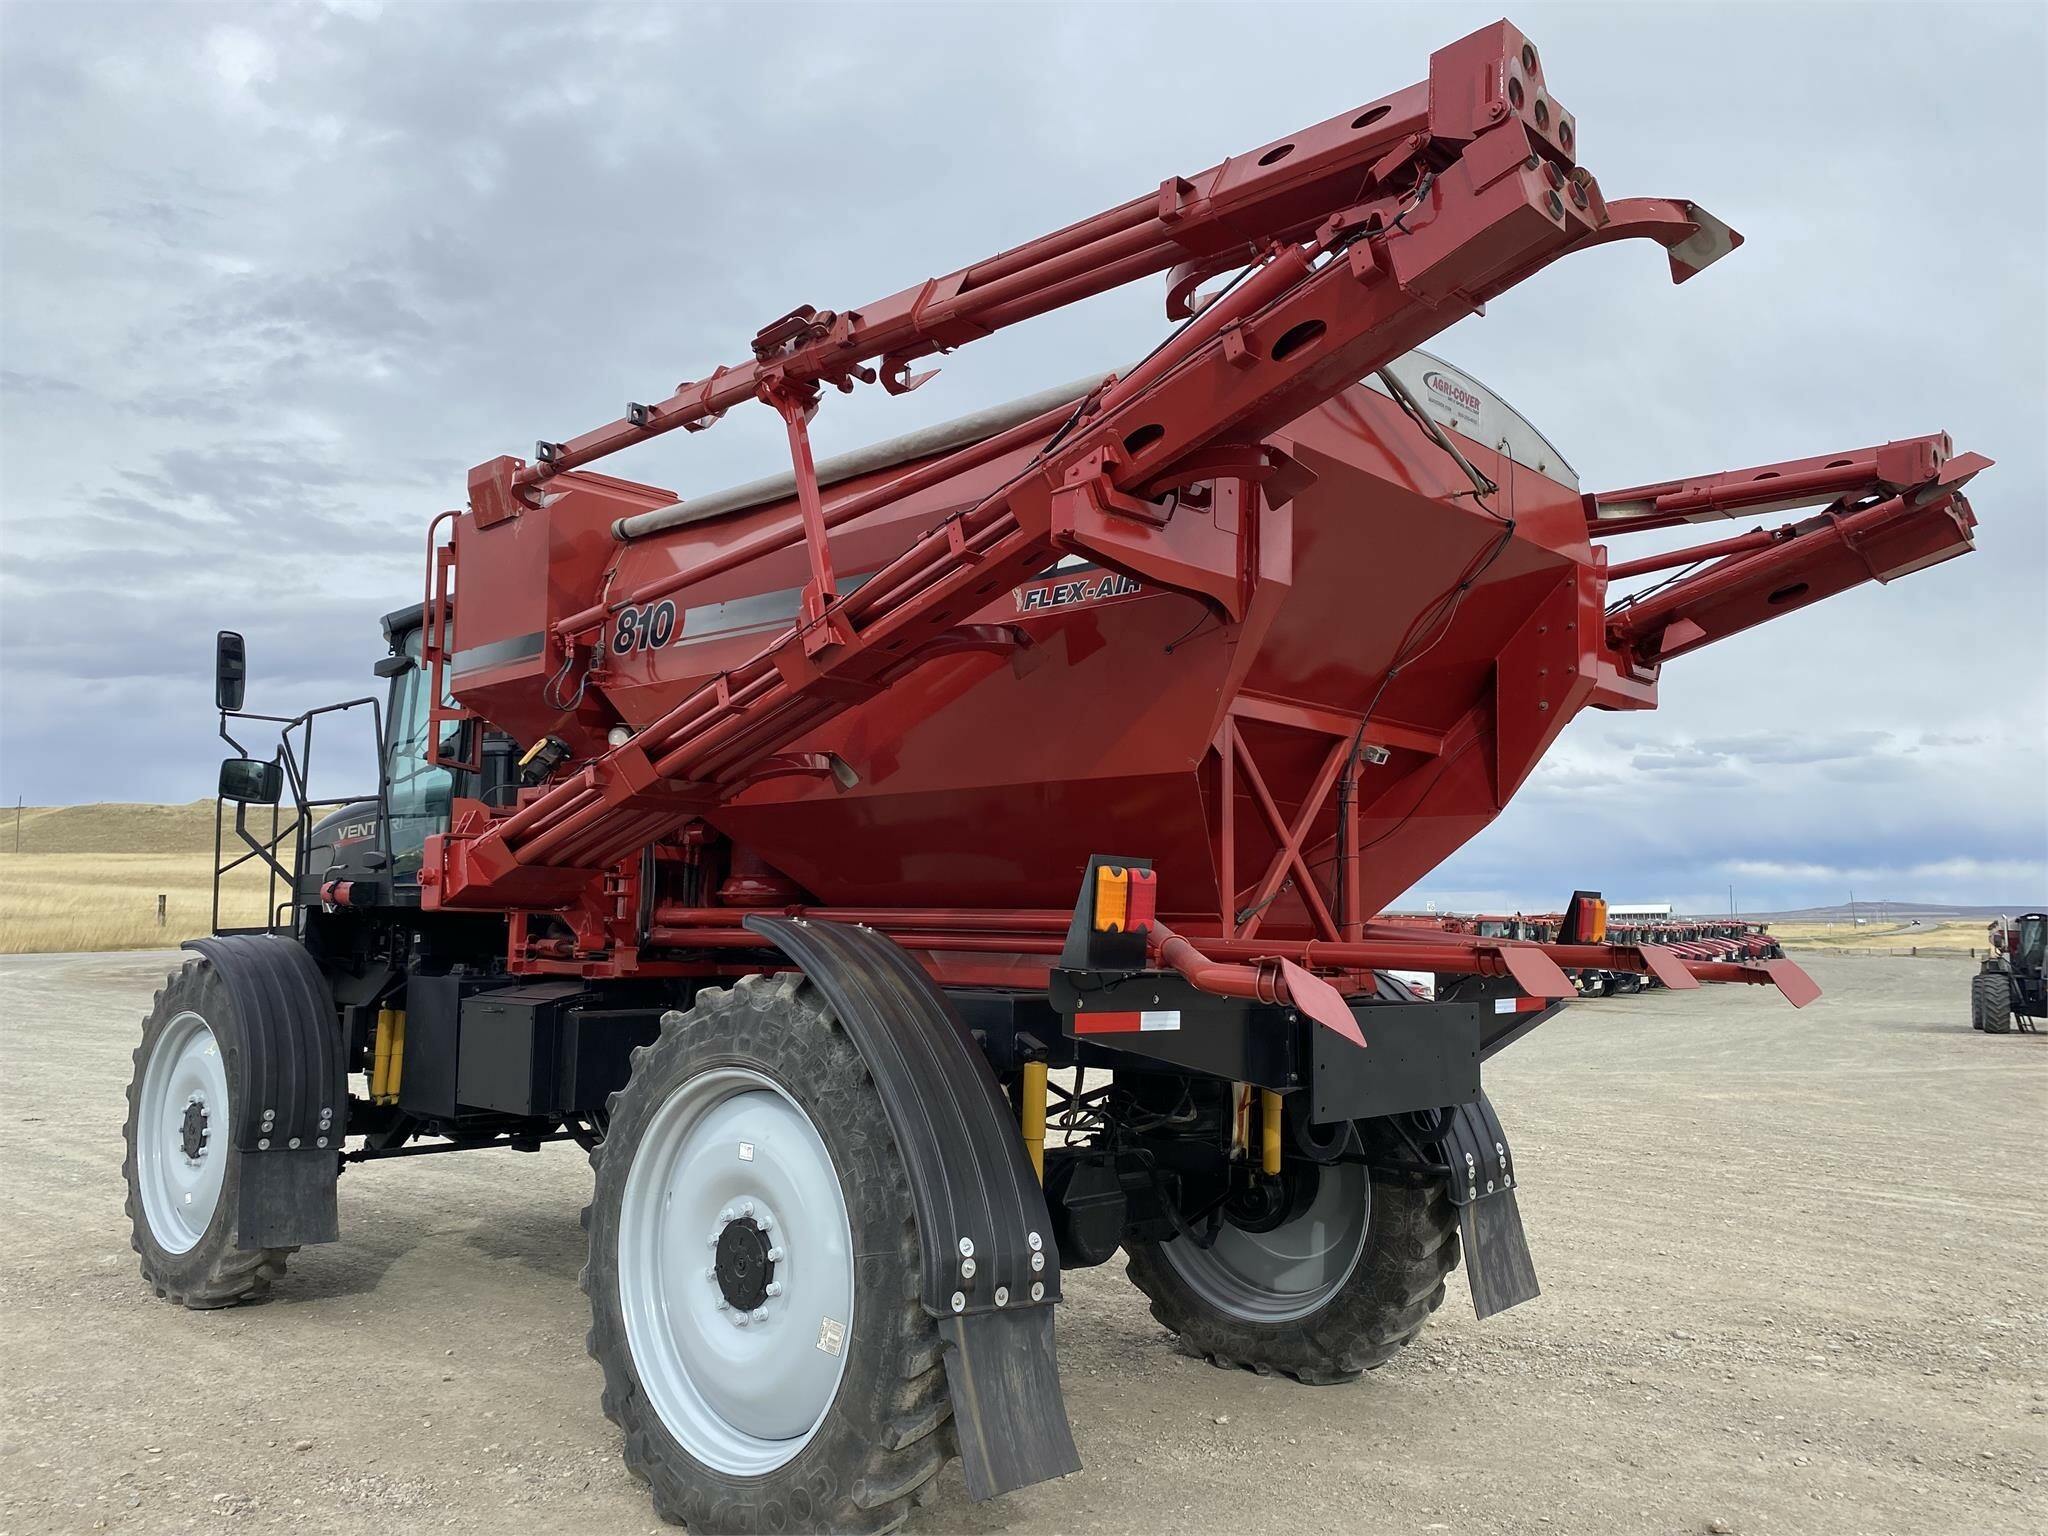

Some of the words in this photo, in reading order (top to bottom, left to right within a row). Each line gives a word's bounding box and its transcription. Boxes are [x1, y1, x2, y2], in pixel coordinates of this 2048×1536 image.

[1432, 376, 1480, 411] AGRI-COVER
[1023, 574, 1142, 612] FLEX-AIR
[612, 600, 676, 656] 810
